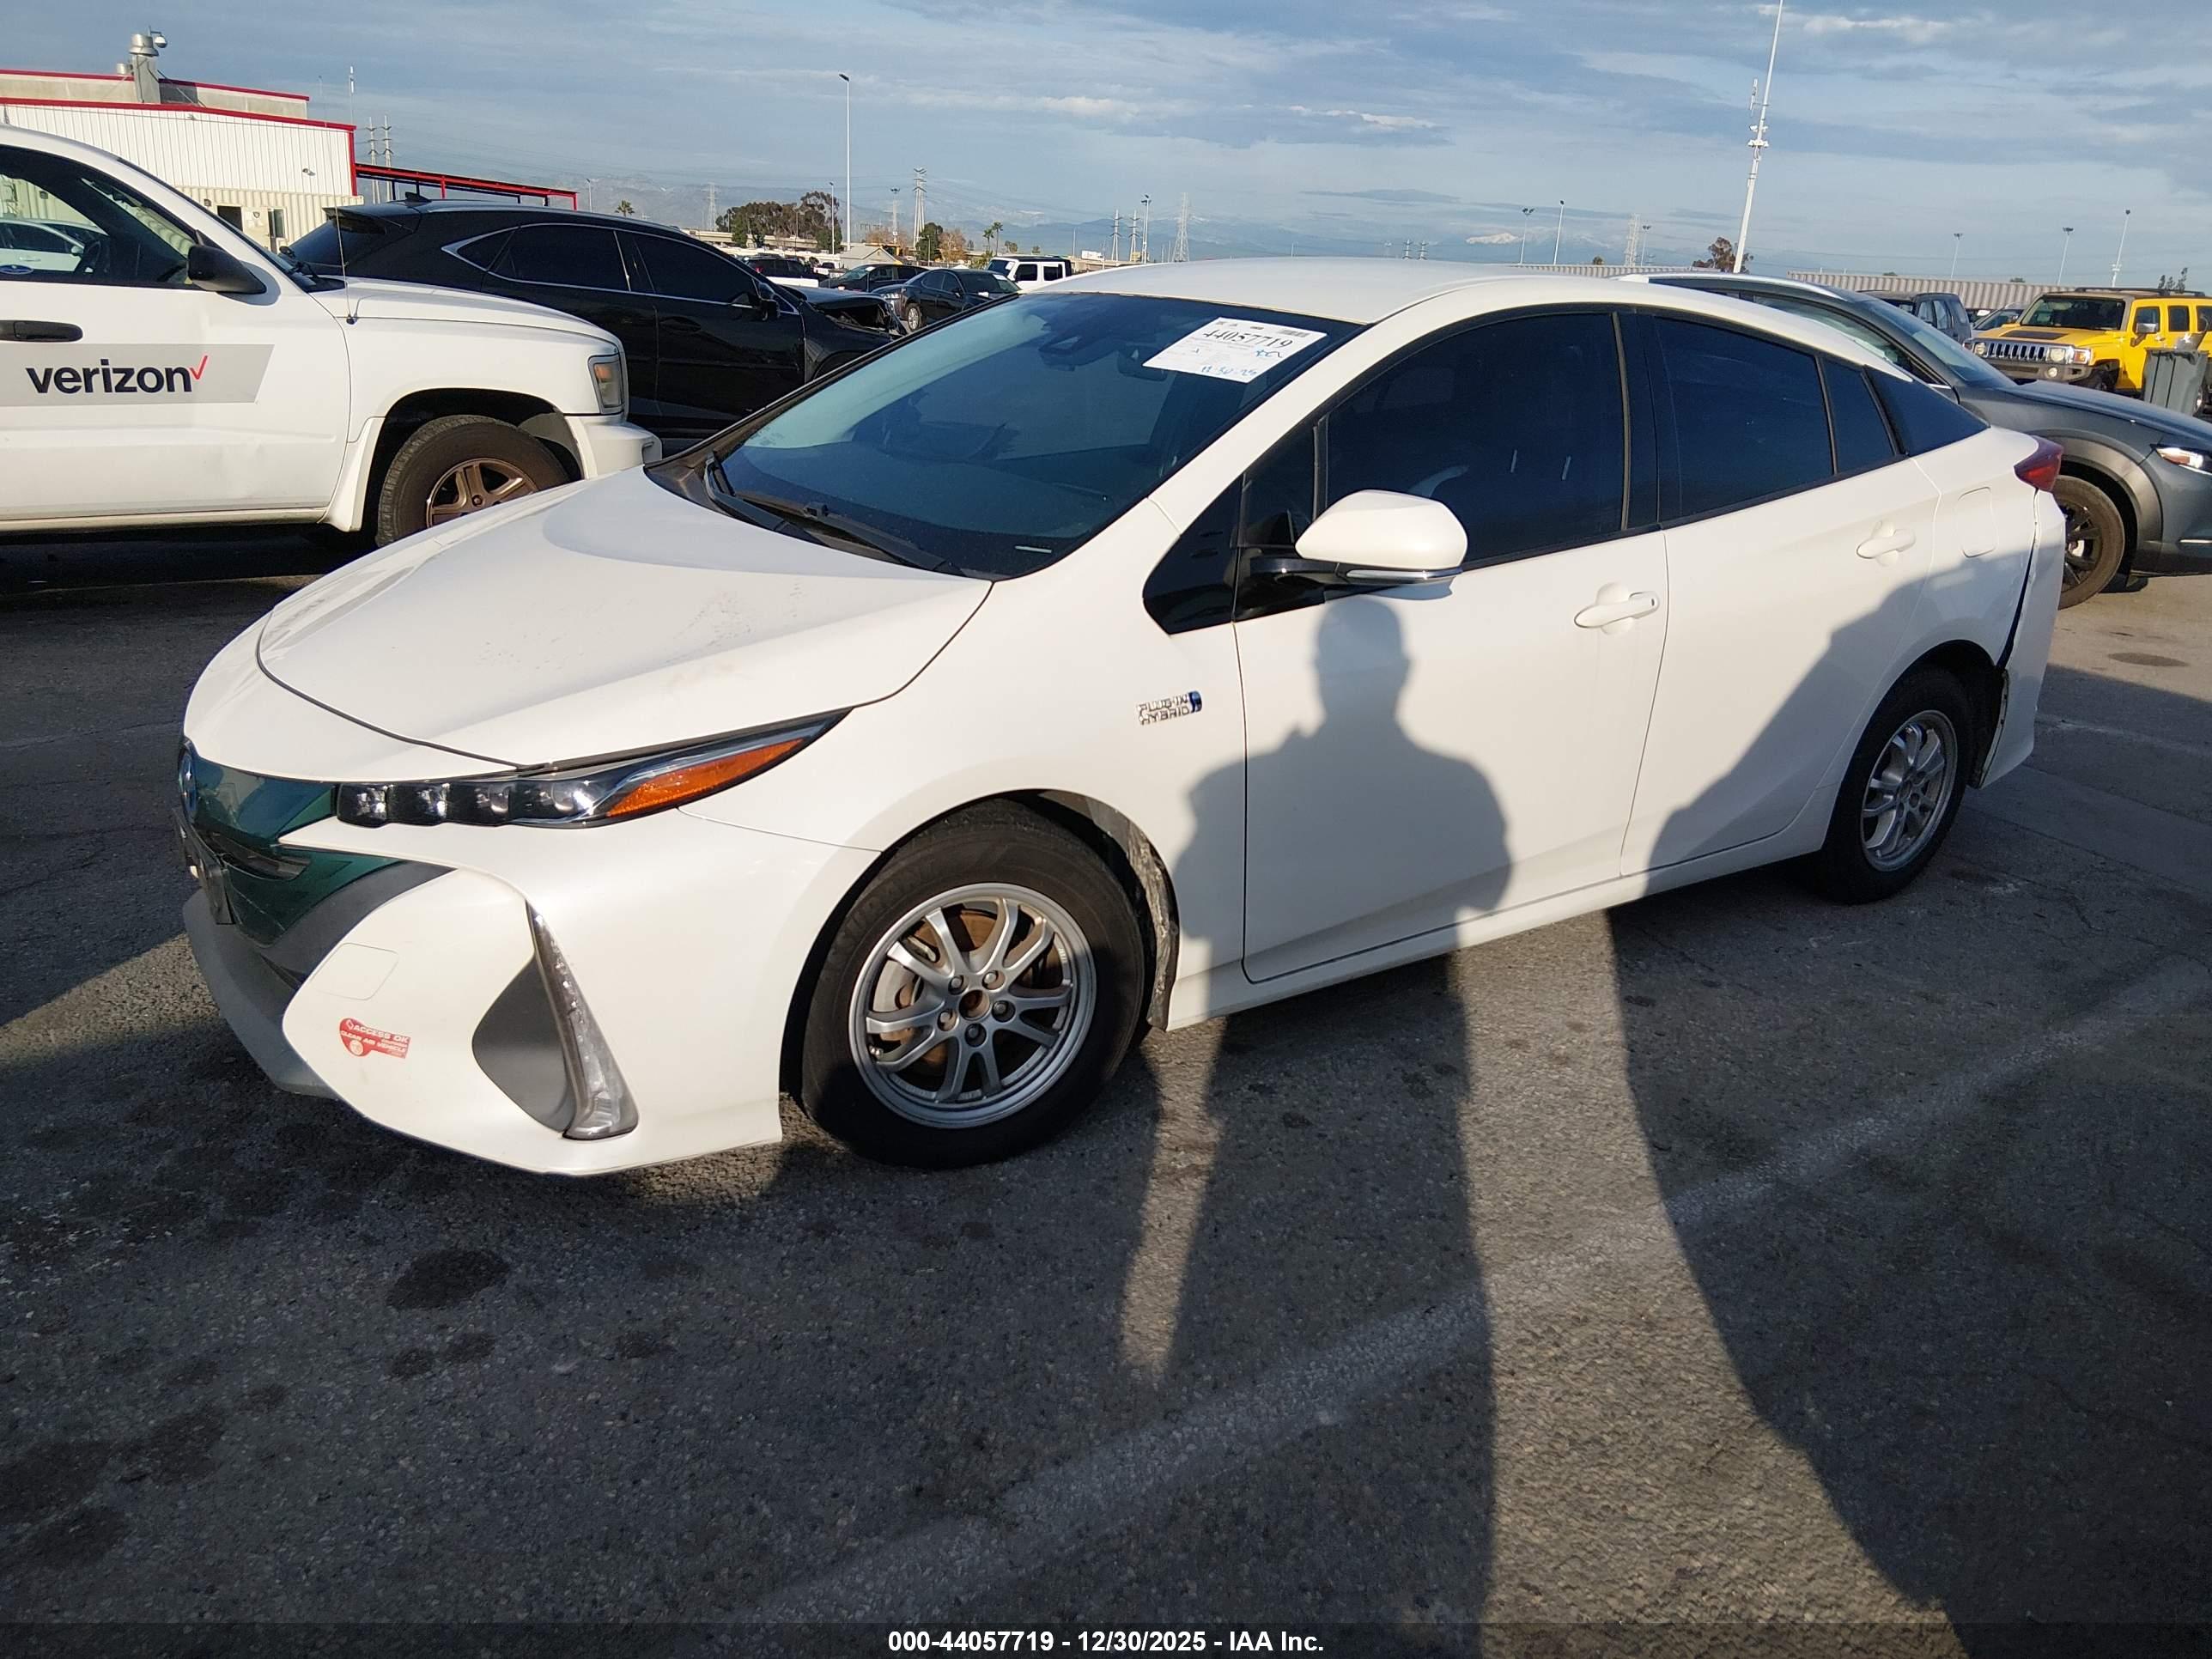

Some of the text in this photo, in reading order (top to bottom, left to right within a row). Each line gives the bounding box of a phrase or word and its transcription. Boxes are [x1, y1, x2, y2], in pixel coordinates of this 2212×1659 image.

[1203, 329, 1293, 348] 44057719
[25, 358, 192, 394] verizon
[1139, 706, 1190, 726] HYBRID
[354, 1025, 392, 1039] ACCESS
[393, 1034, 409, 1043] OK
